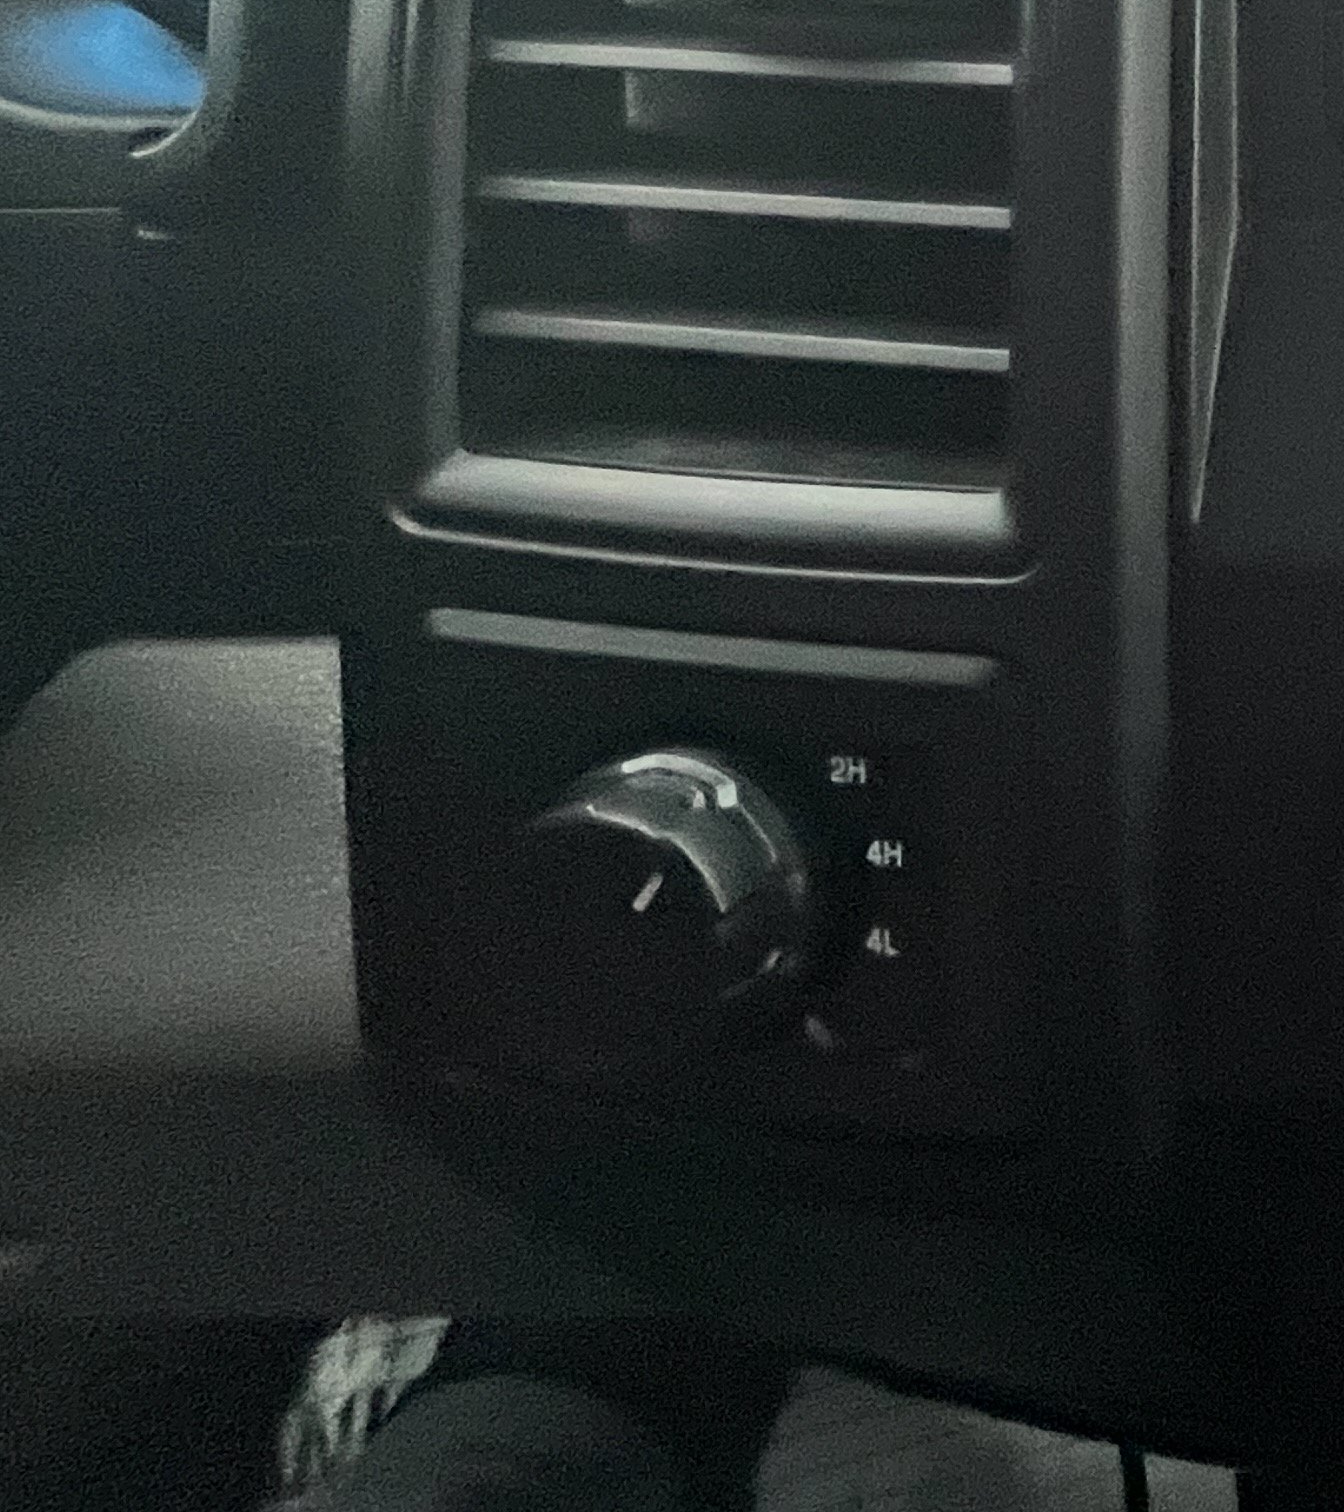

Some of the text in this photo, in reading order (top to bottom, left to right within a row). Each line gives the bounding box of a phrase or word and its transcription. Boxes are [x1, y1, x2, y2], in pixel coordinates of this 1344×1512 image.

[830, 756, 867, 784] 2H
[866, 840, 903, 867] 4H
[865, 927, 899, 957] 4L
